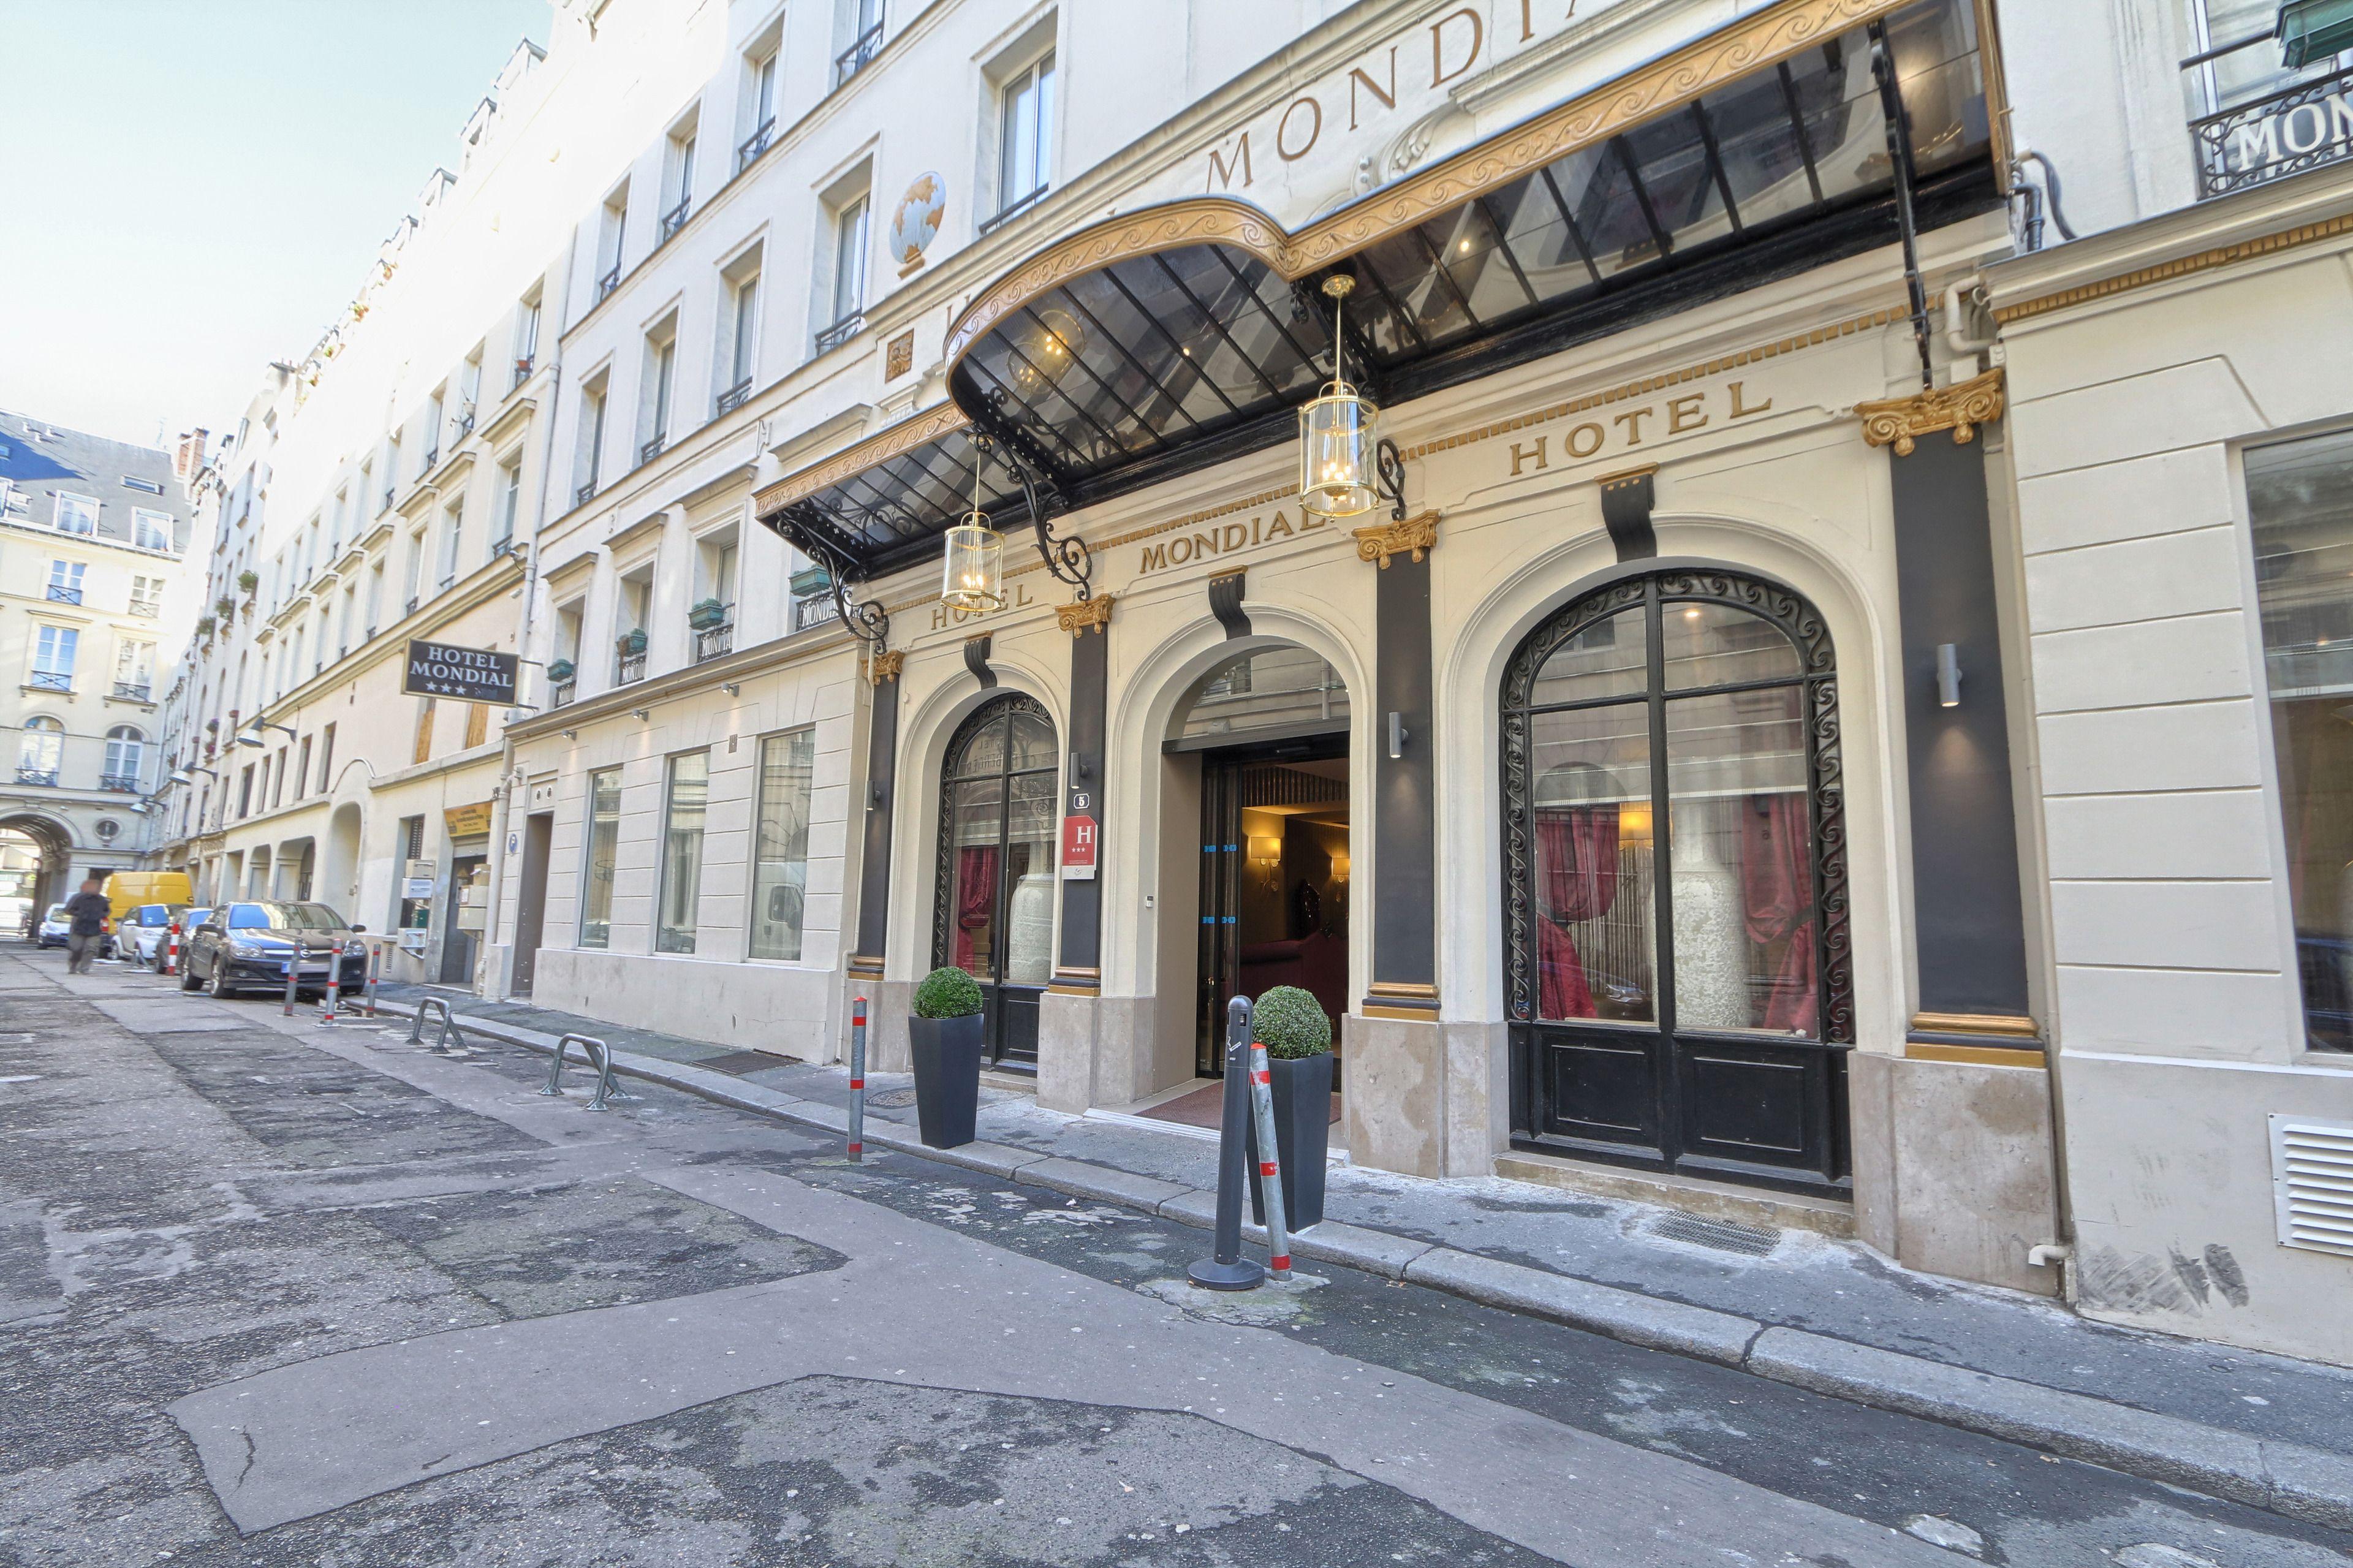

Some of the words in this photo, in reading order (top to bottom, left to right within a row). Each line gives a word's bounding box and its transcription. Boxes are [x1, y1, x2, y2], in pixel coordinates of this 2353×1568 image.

[1207, 0, 1575, 194] MONDI
[1510, 381, 1772, 475] HOTEL
[1139, 502, 1326, 574] MONDIAL
[931, 584, 1033, 630] HOEL
[410, 661, 513, 687] MONDIAL
[428, 646, 501, 670] HOTEL
[1078, 796, 1085, 806] 5
[1076, 825, 1092, 844] H
